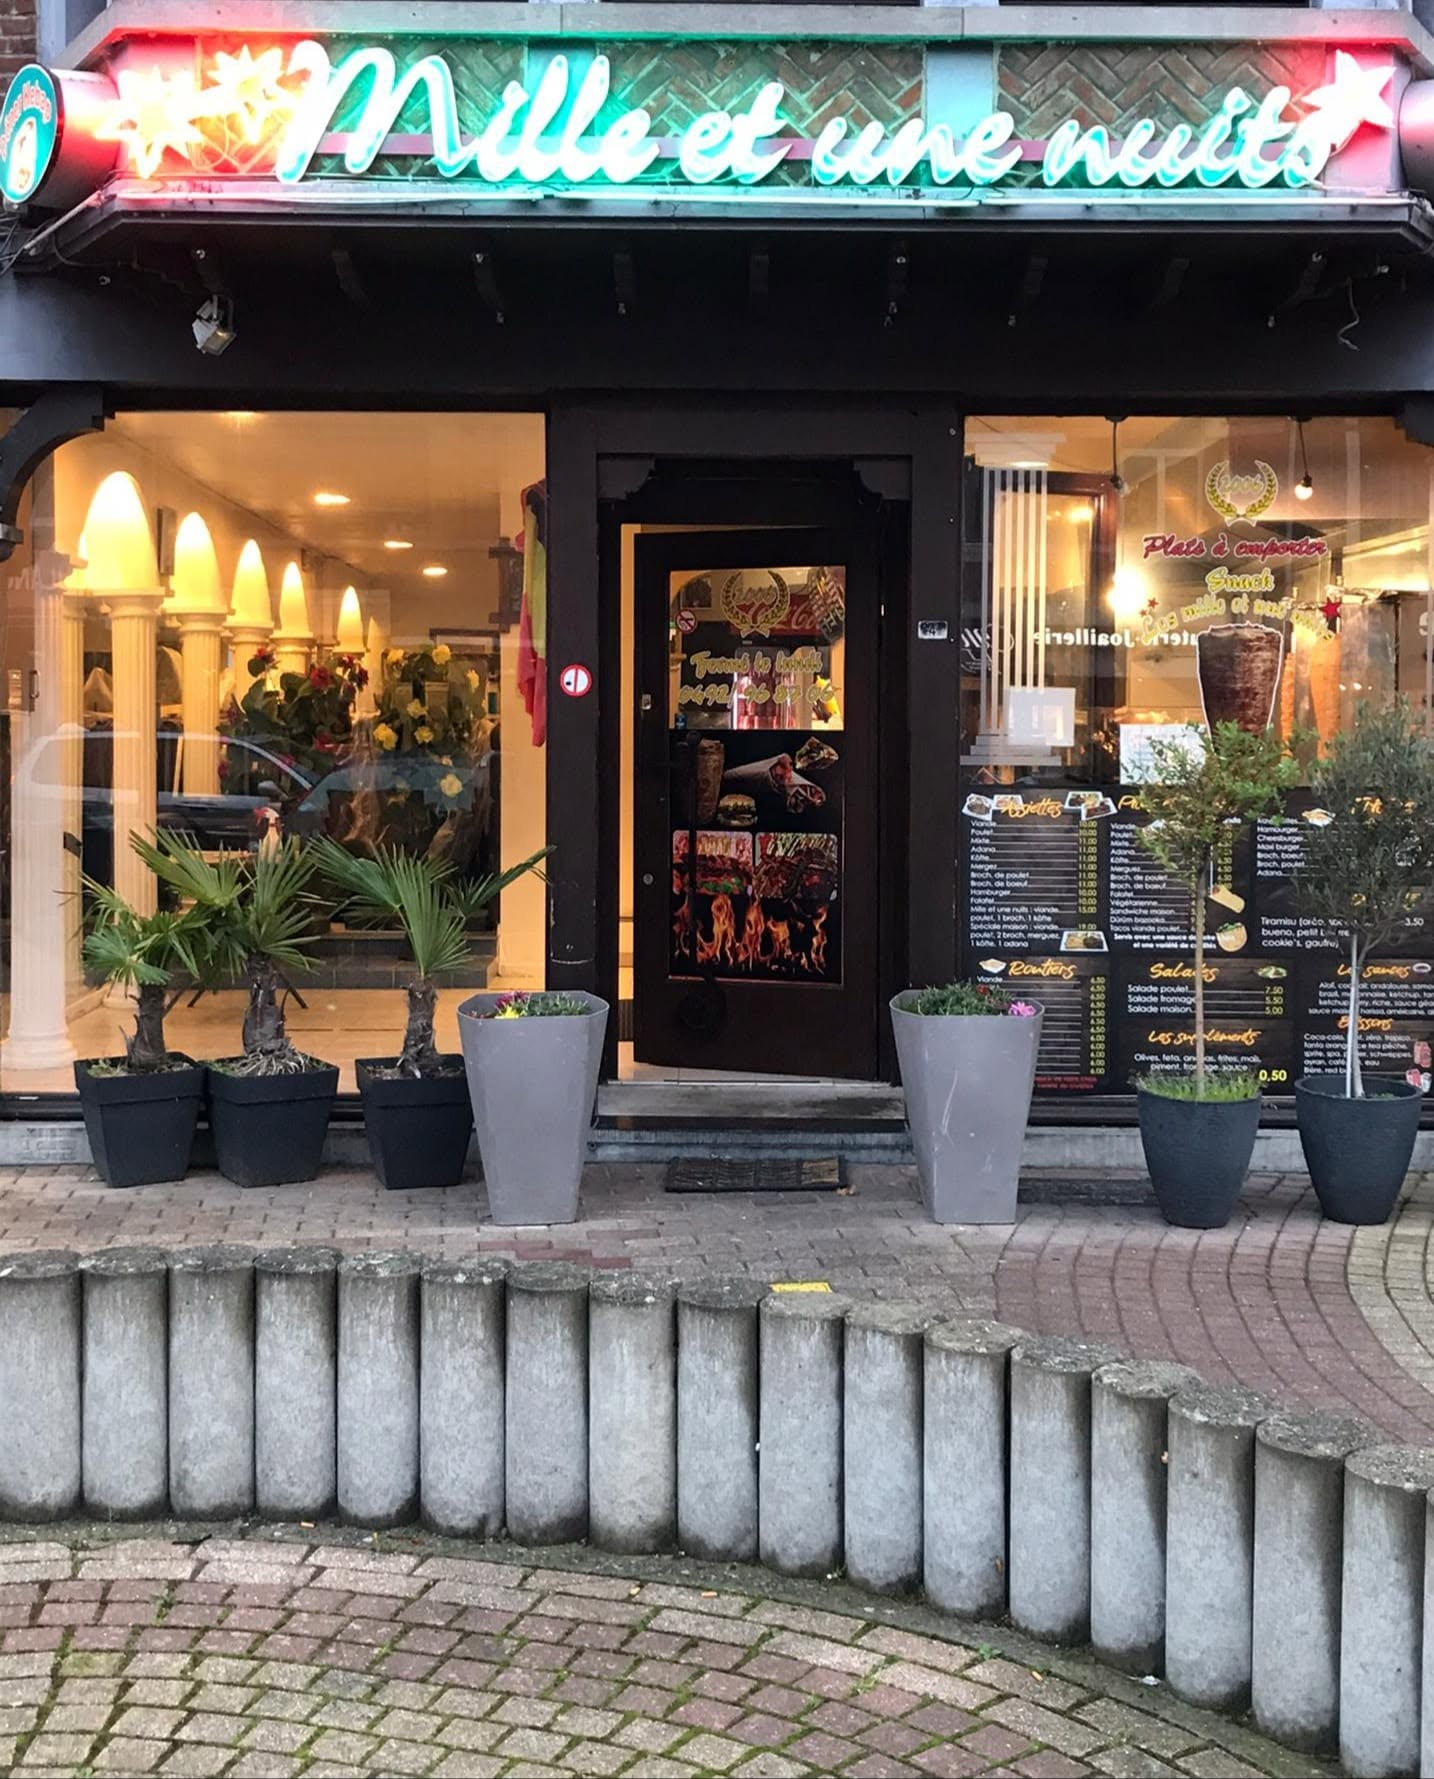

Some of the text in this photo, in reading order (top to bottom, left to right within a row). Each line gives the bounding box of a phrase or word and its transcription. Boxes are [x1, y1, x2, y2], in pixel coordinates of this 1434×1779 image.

[276, 40, 1330, 187] Mille et une nuits
[1143, 532, 1328, 562] Plats à emporter
[1205, 566, 1275, 592] Snack
[1008, 958, 1077, 979] Routiers
[1128, 1005, 1158, 1013] Salade
[1160, 995, 1196, 1004] fromag
[1259, 1070, 1287, 1081] 0.50
